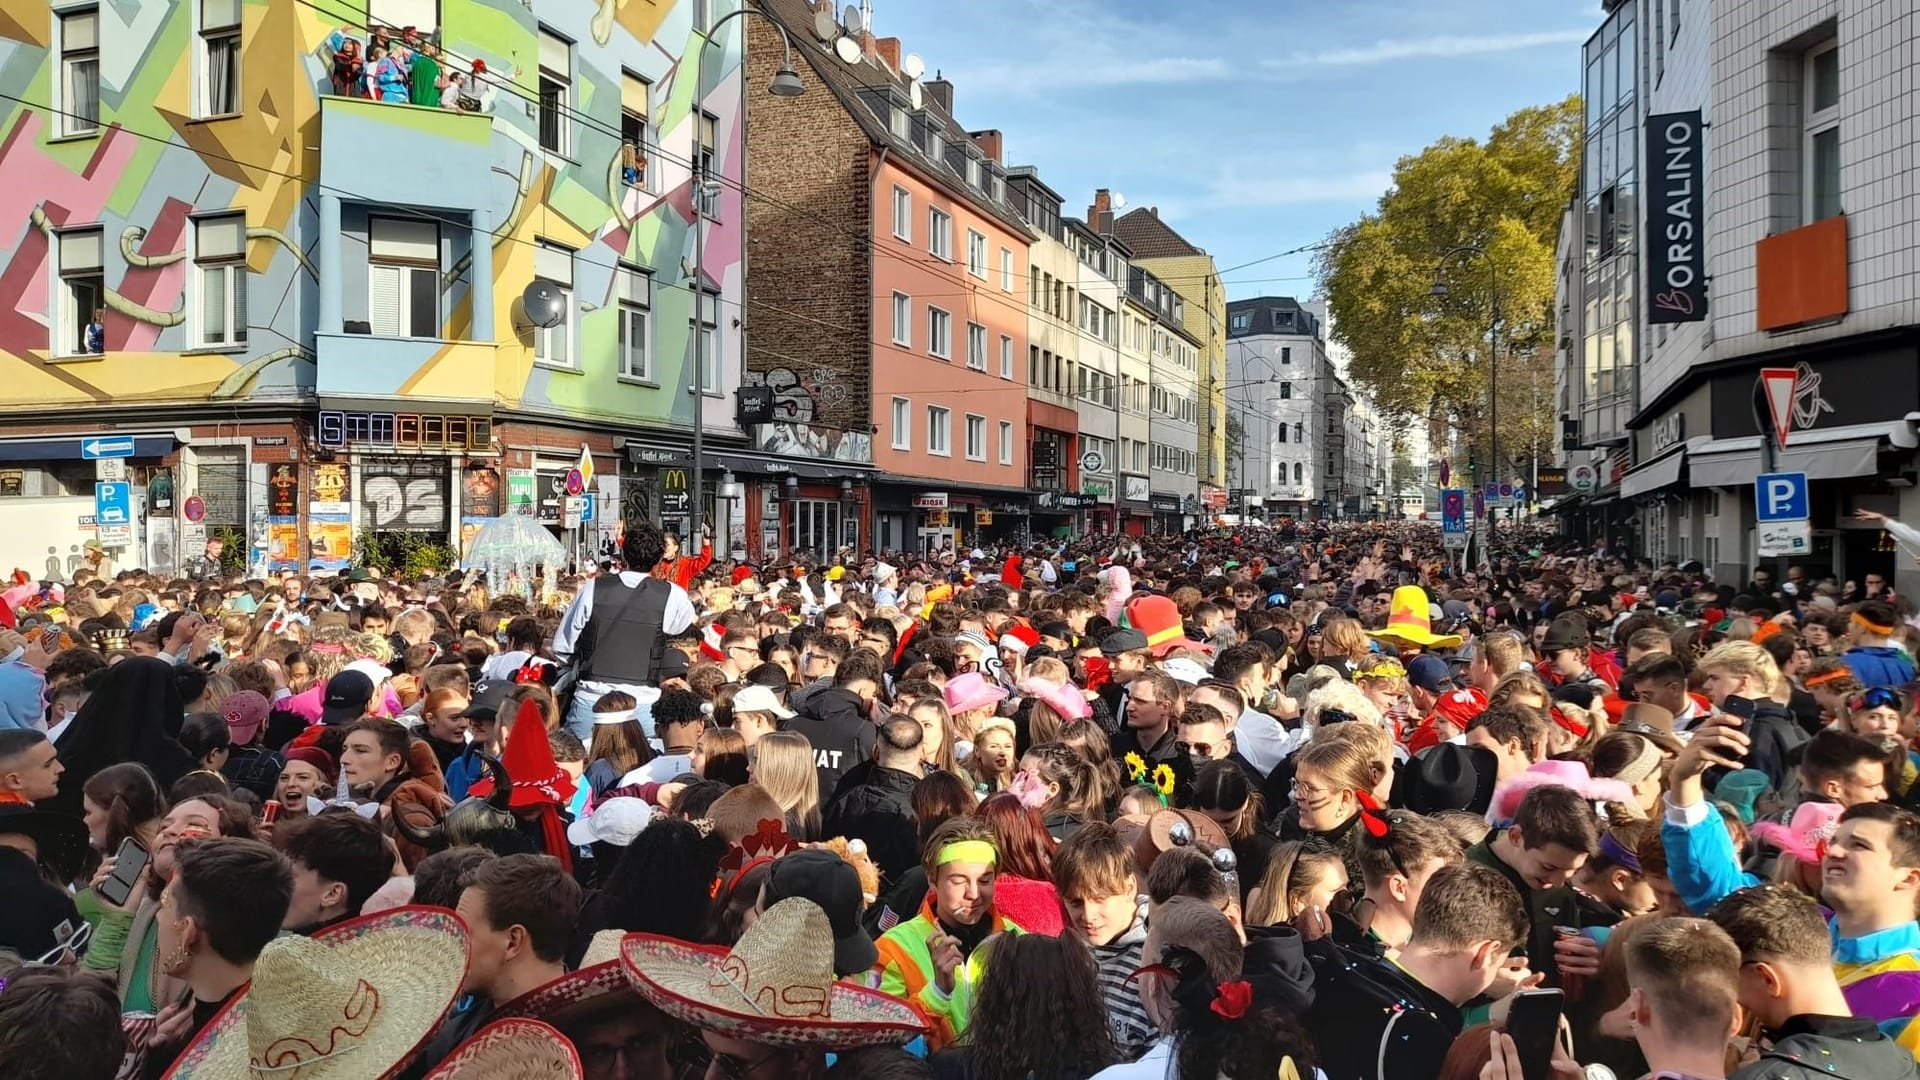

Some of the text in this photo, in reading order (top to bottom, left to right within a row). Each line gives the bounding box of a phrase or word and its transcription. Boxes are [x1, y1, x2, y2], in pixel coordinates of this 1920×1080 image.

[1656, 121, 1694, 316] BORSALINO
[323, 415, 490, 447] STIEFEL
[101, 485, 116, 502] P
[921, 498, 944, 506] KIOSK
[1767, 479, 1796, 515] P
[581, 498, 590, 518] P
[1444, 520, 1464, 531] TAXI
